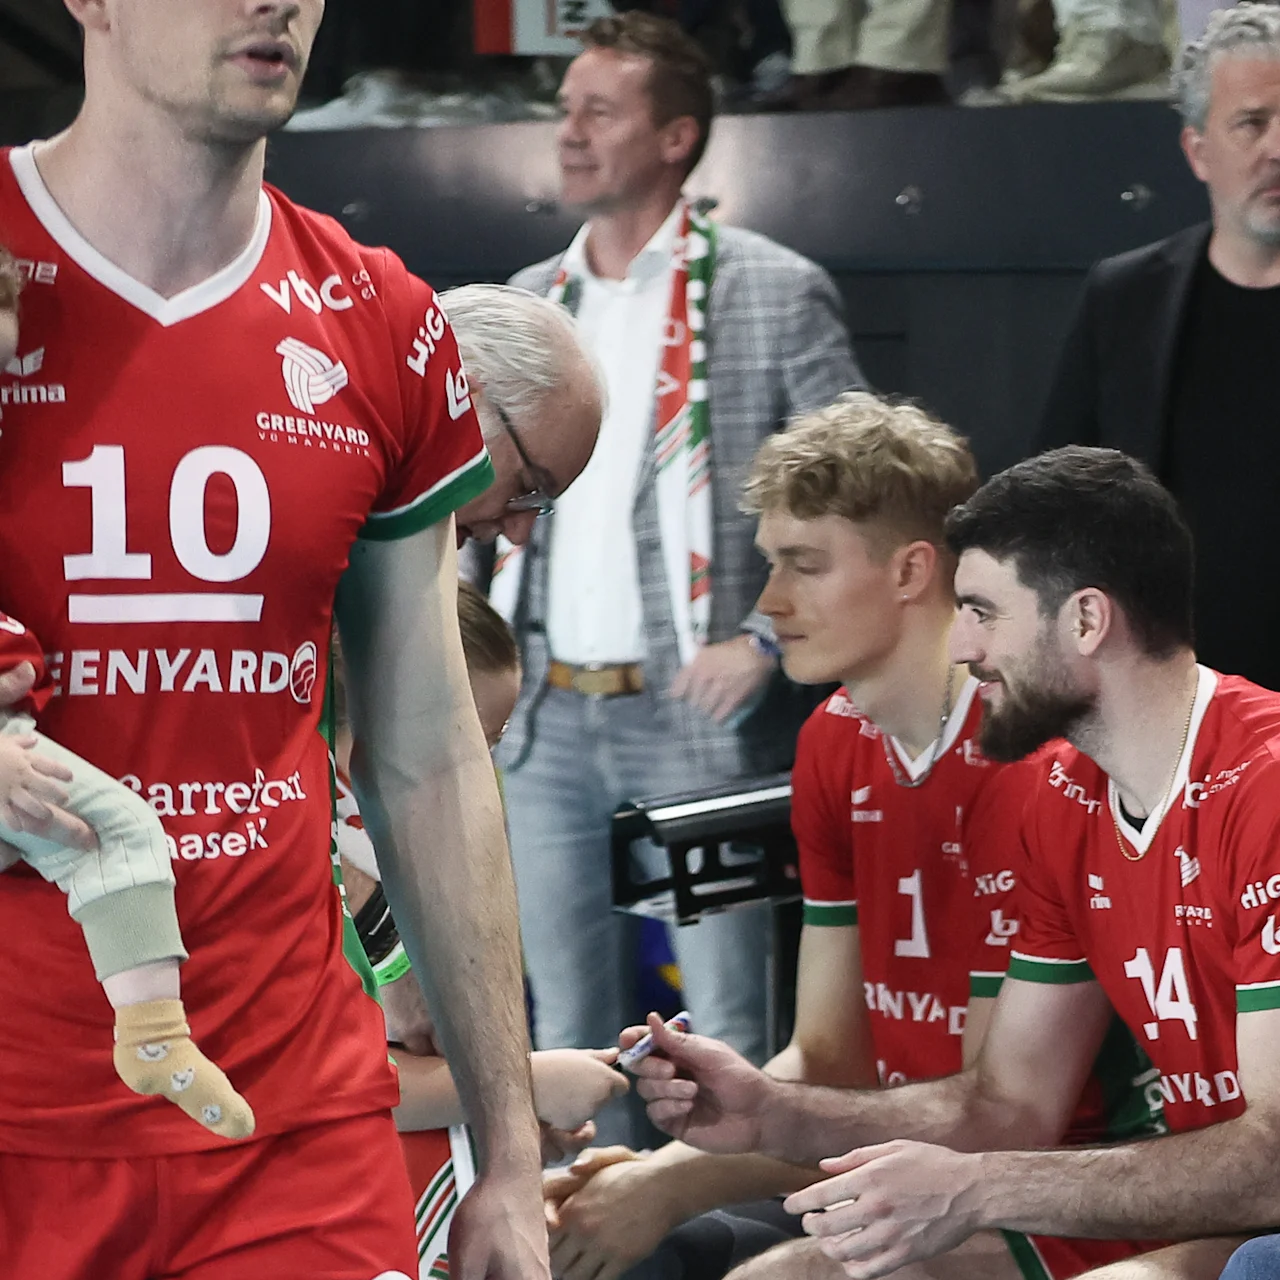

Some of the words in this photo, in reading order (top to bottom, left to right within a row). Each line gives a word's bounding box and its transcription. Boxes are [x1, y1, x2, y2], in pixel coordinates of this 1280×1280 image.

[260, 269, 354, 316] vbc
[0, 380, 66, 405] rima
[256, 411, 371, 447] GREENYARD
[61, 444, 272, 583] 10
[894, 868, 931, 959] 1
[1123, 947, 1198, 1041] 14
